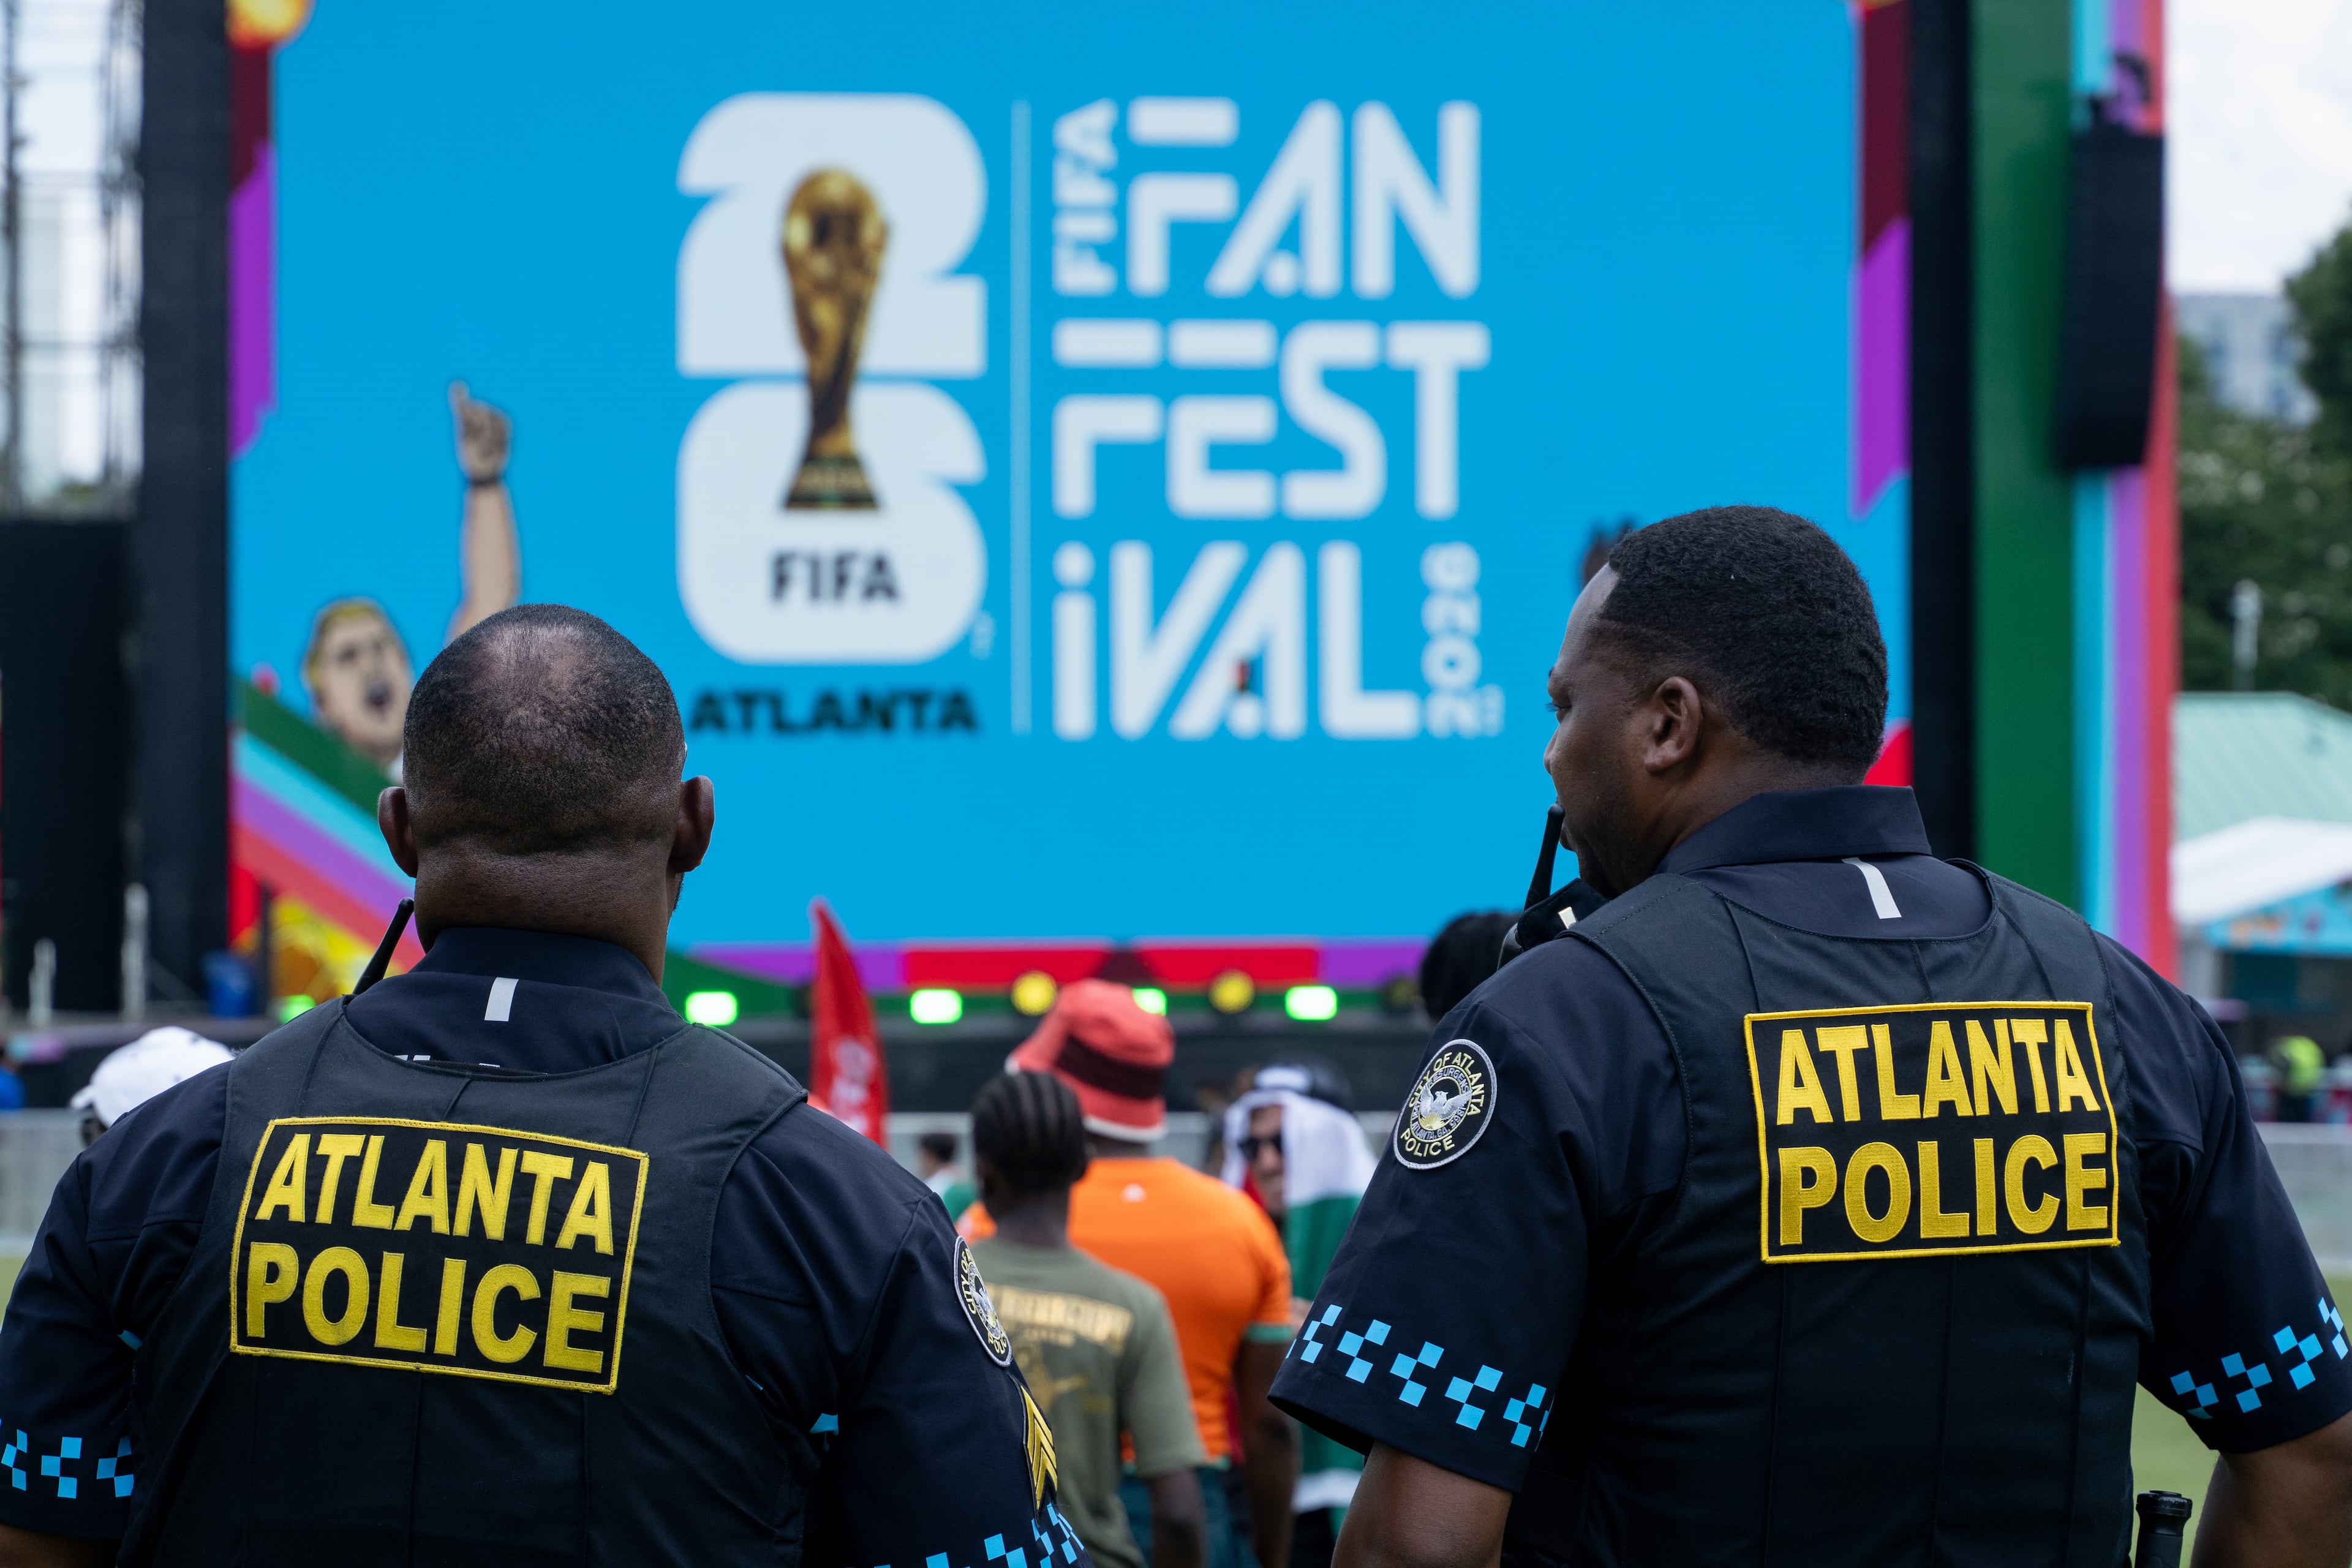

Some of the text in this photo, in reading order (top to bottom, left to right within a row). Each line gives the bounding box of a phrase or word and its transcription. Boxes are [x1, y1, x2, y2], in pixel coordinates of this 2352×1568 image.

[1052, 98, 1118, 298] FIFA
[1126, 96, 1482, 299] FAN
[1052, 318, 1491, 520] FEST
[771, 547, 902, 605] FIFA
[1420, 541, 1482, 739] 2026
[688, 686, 981, 735] ATLANTA
[1409, 1052, 1485, 1115] CITY OF ATLANTA
[1427, 1067, 1469, 1094] RESURGENS
[1777, 1018, 2101, 1125] ATLANTA
[255, 1134, 614, 1255] ATLANTA
[1400, 1128, 1455, 1157] POLICE
[1778, 1133, 2108, 1246] POLICE
[246, 1242, 611, 1373] POLICE
[961, 1273, 976, 1314] CITY
